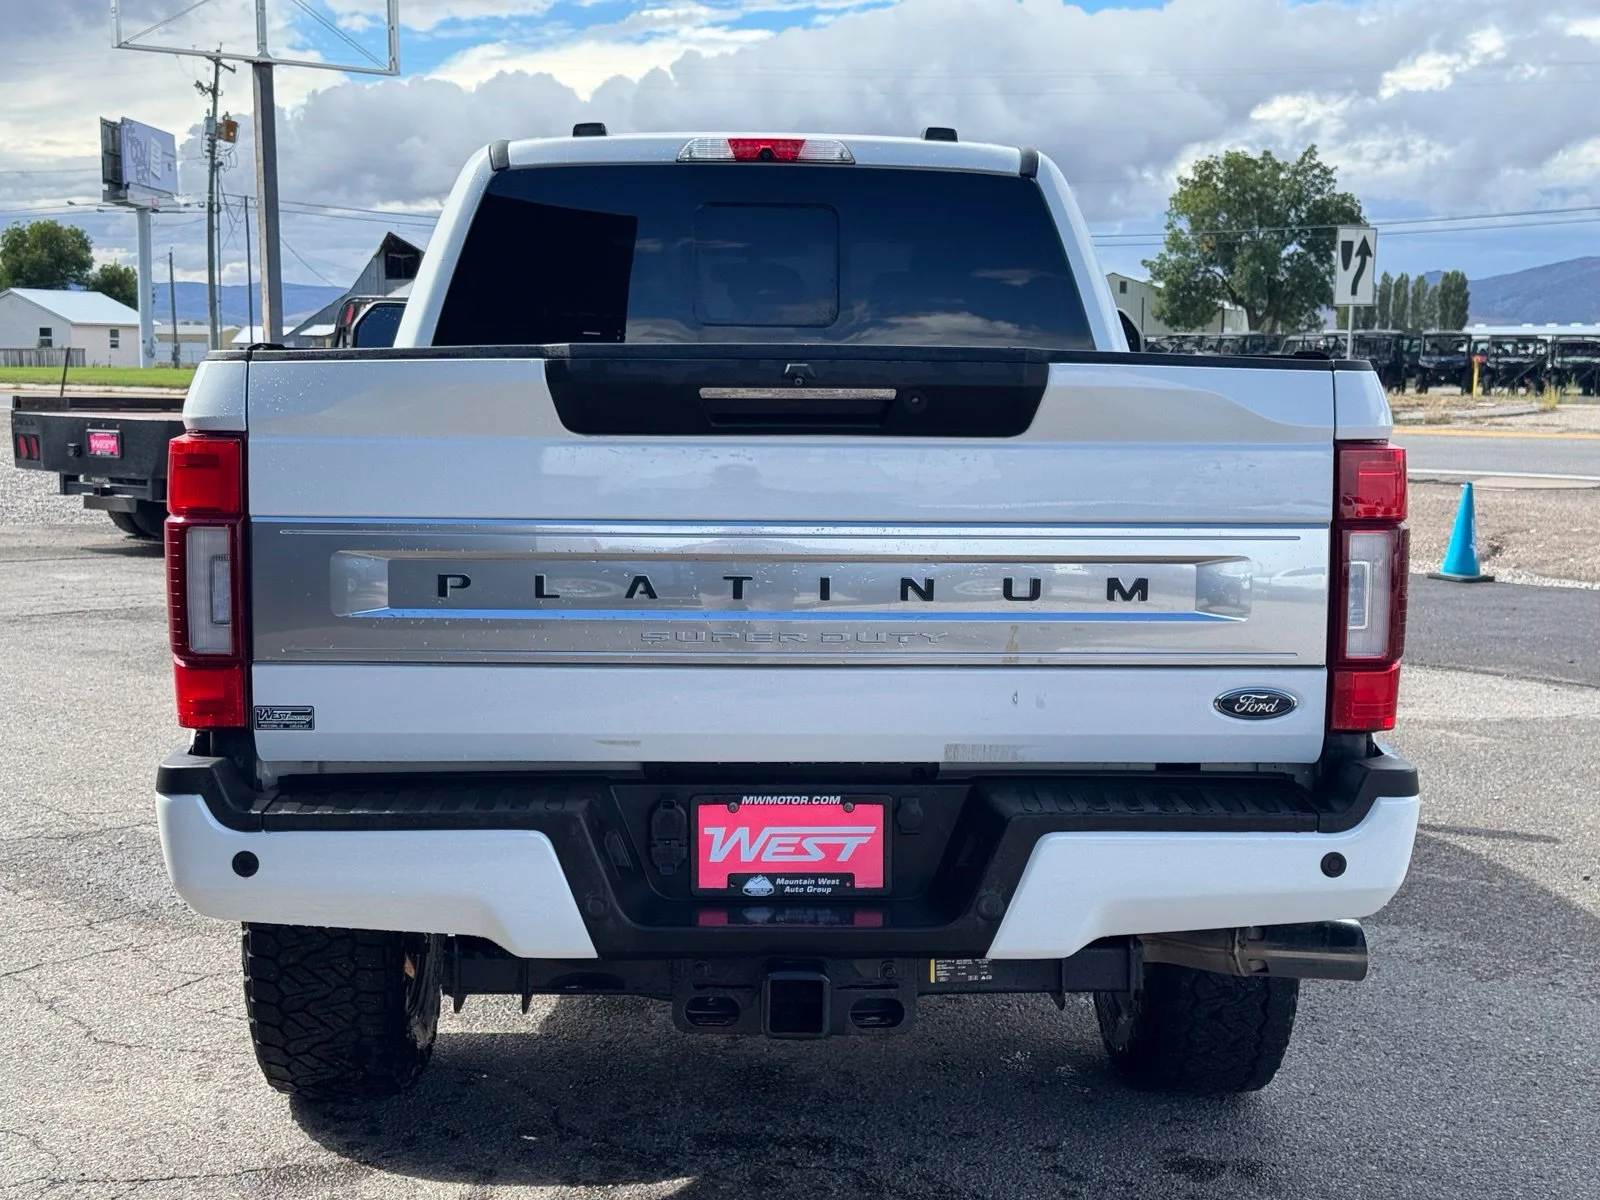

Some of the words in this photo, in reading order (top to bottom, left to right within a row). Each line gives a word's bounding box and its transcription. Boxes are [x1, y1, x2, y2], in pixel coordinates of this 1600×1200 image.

[436, 573, 1149, 602] PLATINUM
[640, 631, 808, 644] SUPER
[820, 631, 948, 644] DUTY
[1234, 694, 1280, 713] Ford
[741, 795, 841, 805] MWMOTOR.COM
[703, 826, 877, 863] WEST
[806, 886, 832, 895] Group
